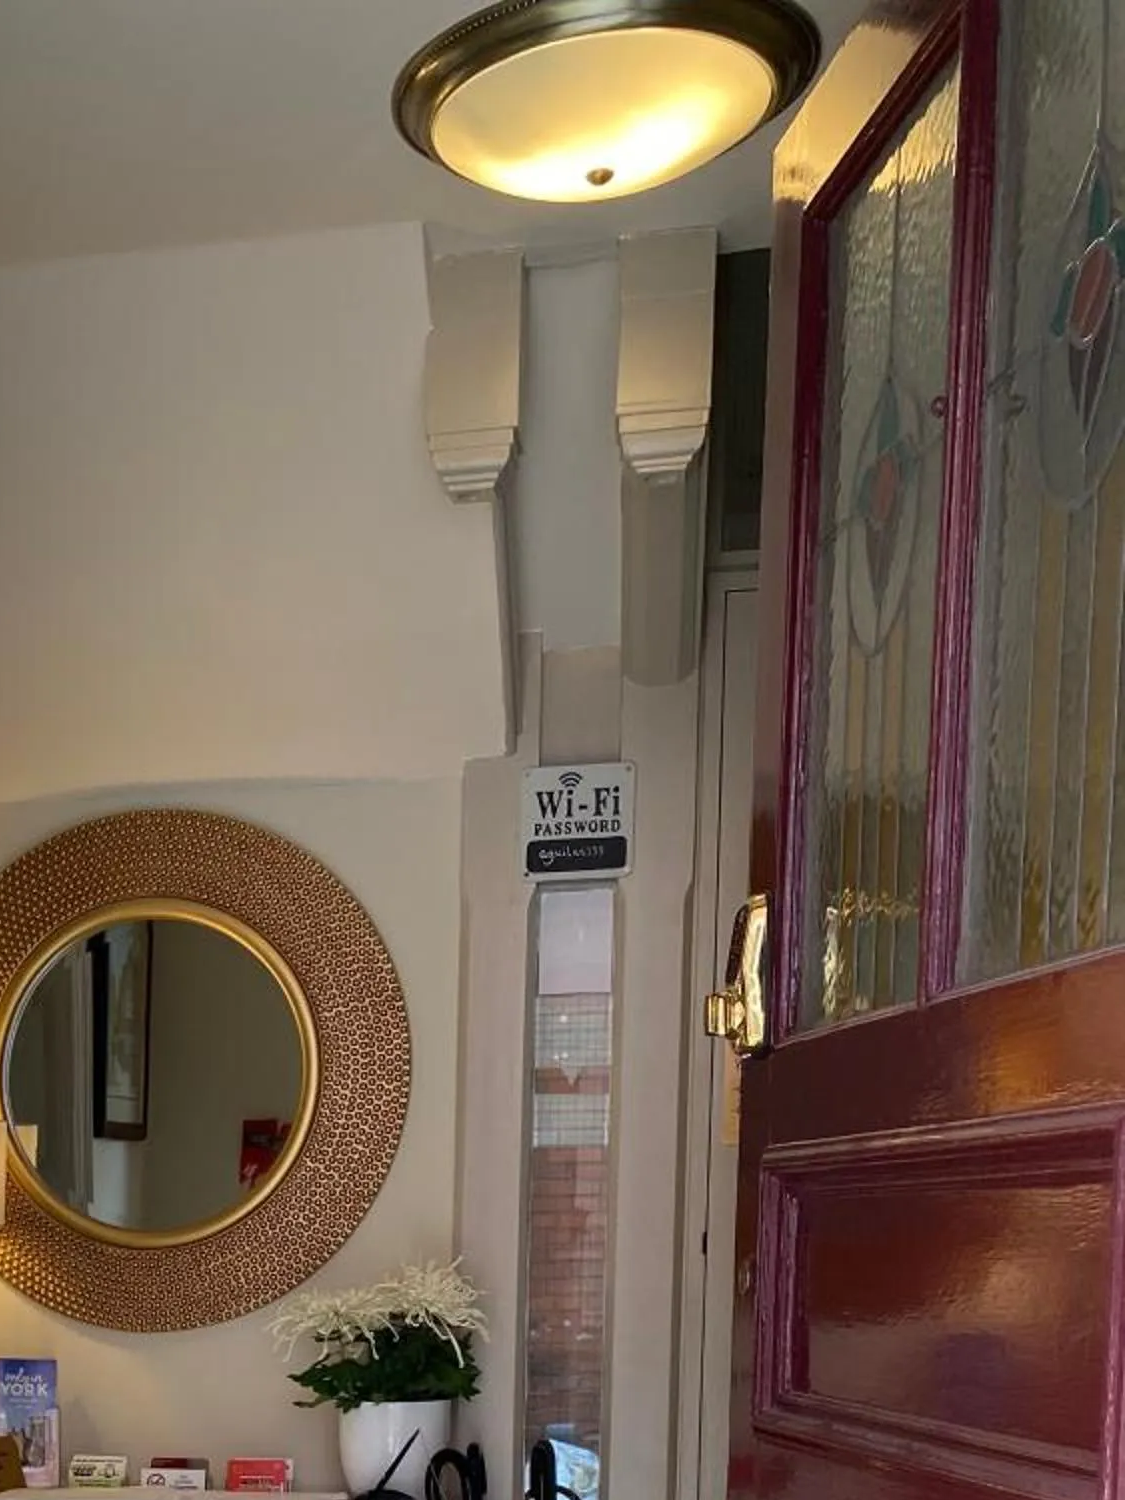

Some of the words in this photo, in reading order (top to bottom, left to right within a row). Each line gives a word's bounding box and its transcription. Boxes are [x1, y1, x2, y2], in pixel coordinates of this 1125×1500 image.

[536, 785, 620, 819] Wi-Fi
[534, 819, 621, 837] PASSWORD
[0, 1381, 48, 1397] YORK
